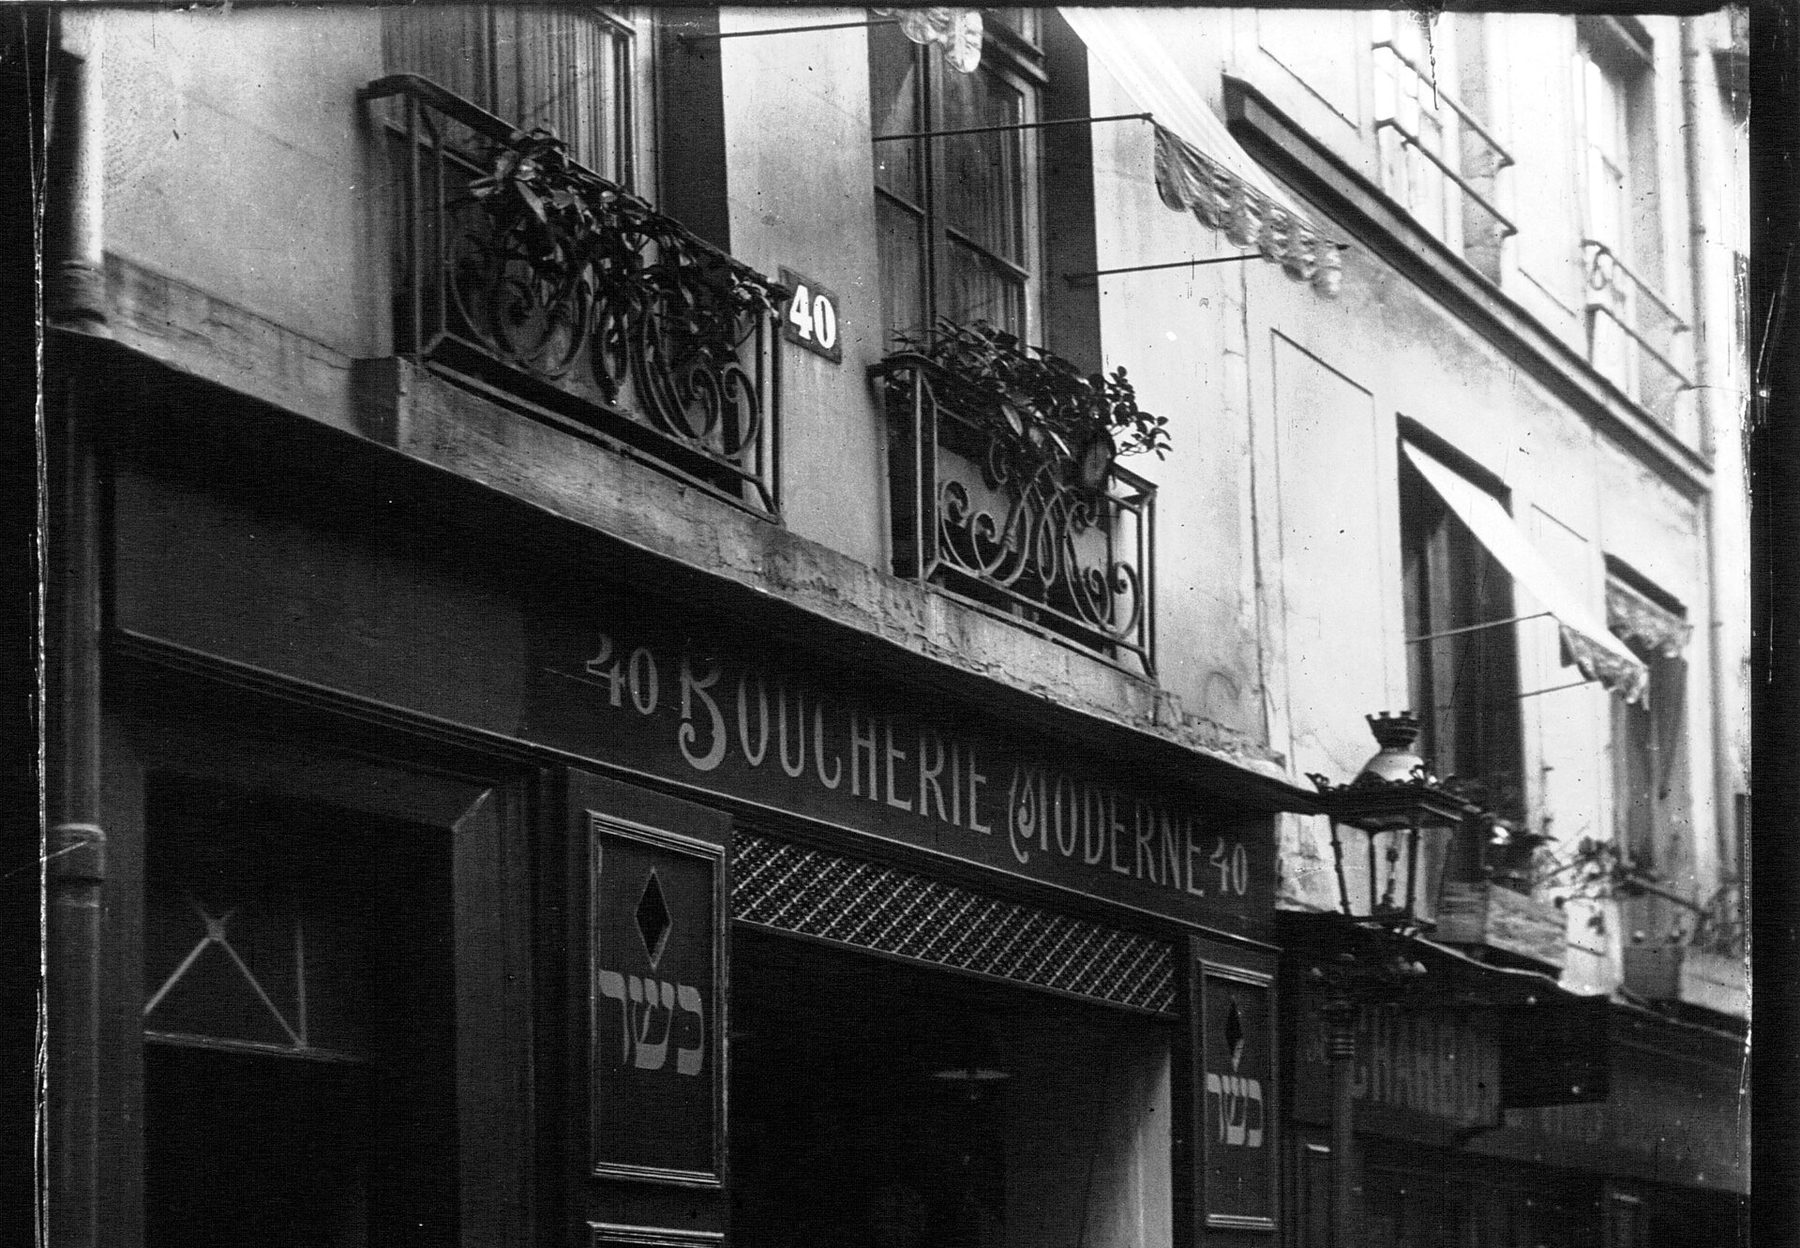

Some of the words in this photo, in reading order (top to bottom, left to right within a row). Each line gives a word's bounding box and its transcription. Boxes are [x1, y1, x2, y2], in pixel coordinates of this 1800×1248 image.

[789, 284, 837, 349] 40
[586, 633, 660, 716] 40
[678, 655, 992, 836] BOUCHERIE
[1008, 765, 1205, 897] MODERNE
[1210, 836, 1248, 896] 40
[598, 968, 704, 1076] כשר
[1205, 1073, 1263, 1148] כשר
